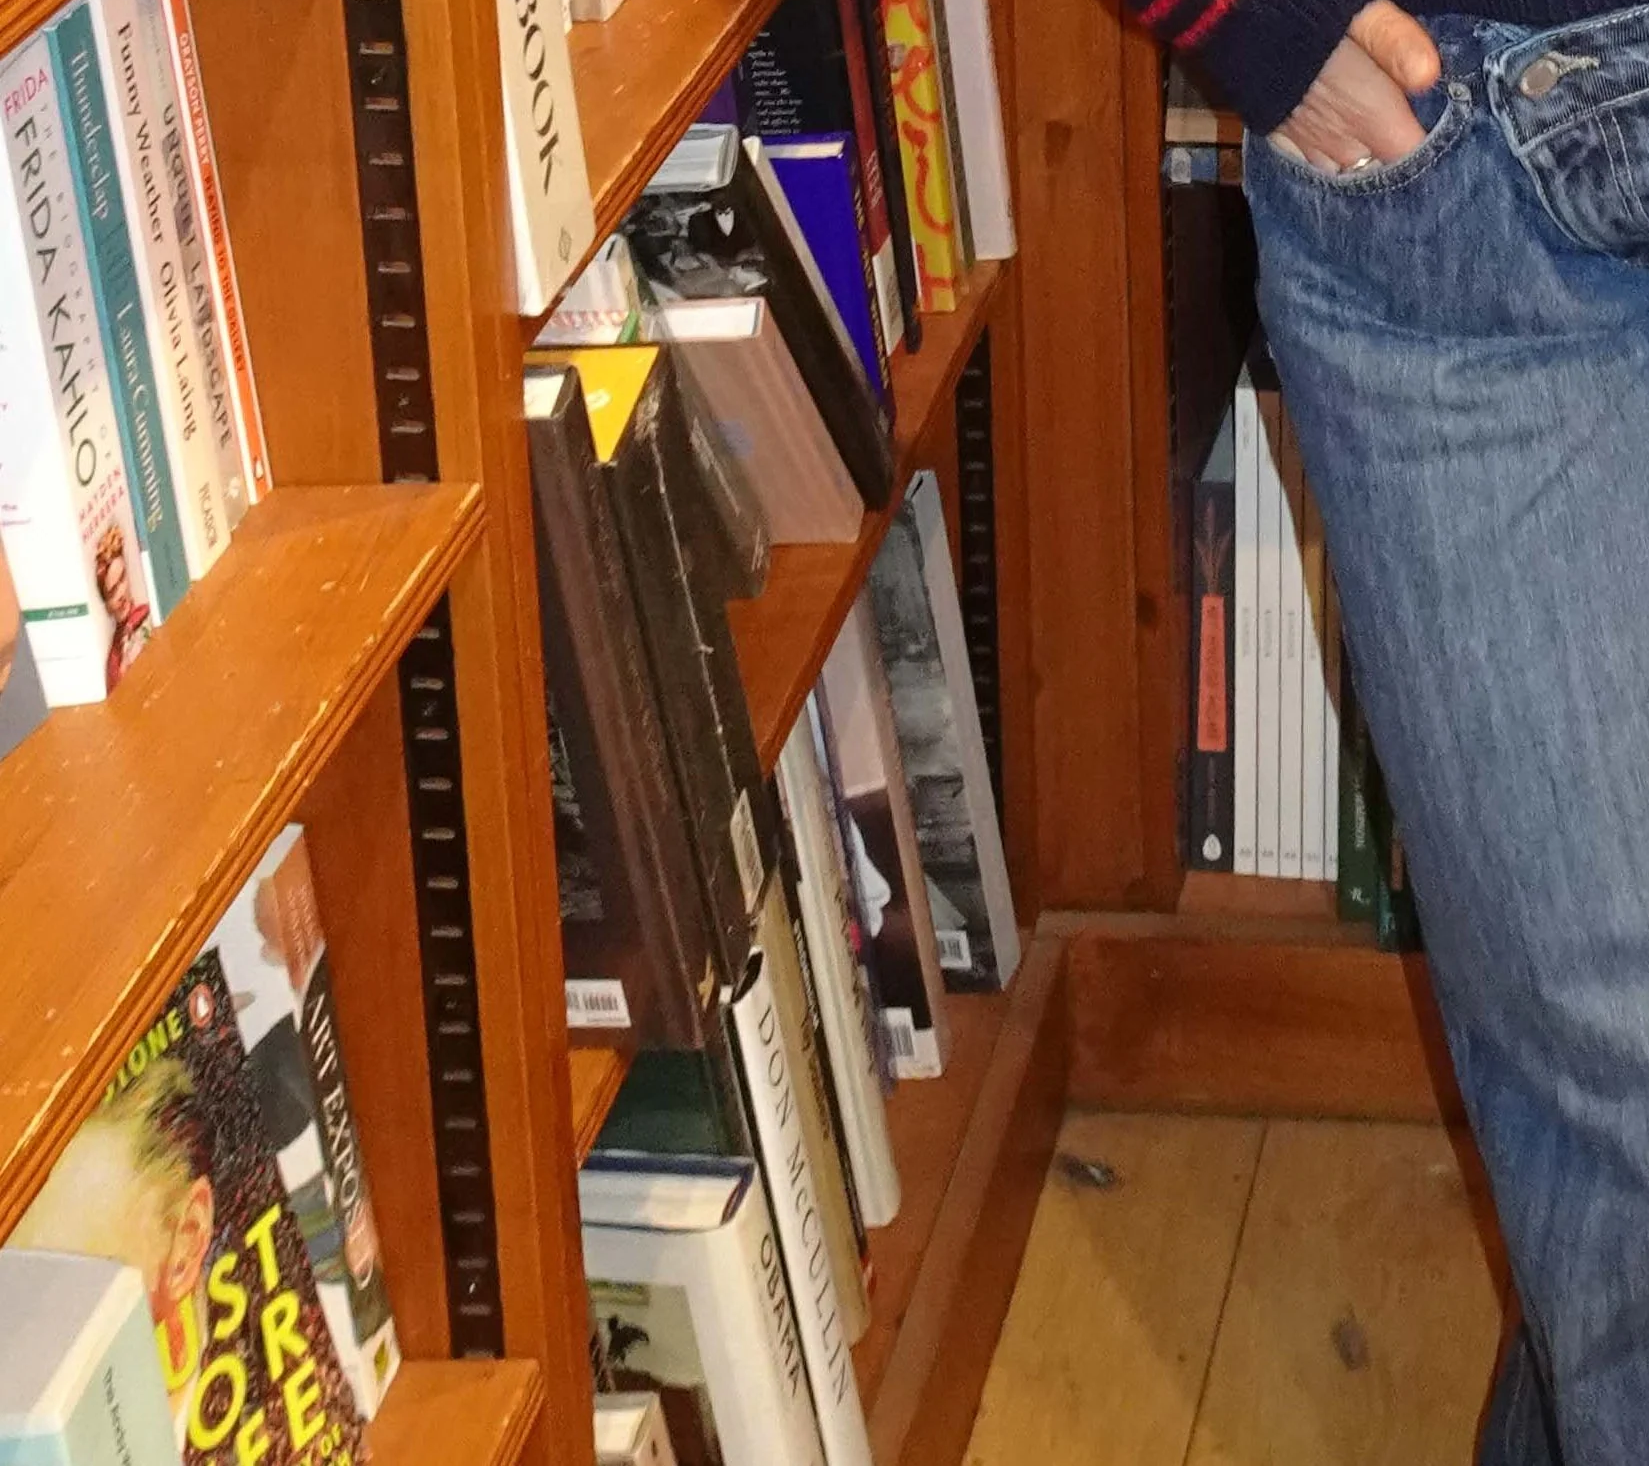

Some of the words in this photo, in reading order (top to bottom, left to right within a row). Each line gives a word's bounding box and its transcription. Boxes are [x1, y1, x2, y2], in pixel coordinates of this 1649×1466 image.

[4, 68, 49, 120] FRIDA
[178, 32, 201, 112] GRAYSON
[190, 115, 210, 165] PERRY
[220, 276, 234, 300] THE
[227, 309, 246, 373] GALLERY
[15, 118, 59, 284] FRIDA
[46, 297, 98, 487] KAHLO
[40, 103, 58, 161] THE
[59, 193, 100, 394] BIOGRAPHY
[98, 425, 113, 461] OF
[68, 47, 112, 219] Thunderclap
[116, 301, 143, 385] Laura
[131, 385, 166, 534] Cumming
[118, 24, 145, 115] Funny
[136, 119, 166, 244] Weather
[157, 261, 185, 348] Olivia
[174, 357, 200, 442] Laing
[198, 483, 219, 549] PICADOR
[189, 262, 233, 452] LANDSCAPE
[80, 469, 122, 522] HAYDEN
[82, 489, 126, 541] HERRERA
[322, 1088, 374, 1290] EXPOSED
[758, 1005, 795, 1129] DON
[785, 1143, 853, 1407] McCULLIN
[759, 1234, 802, 1398] OBAMA
